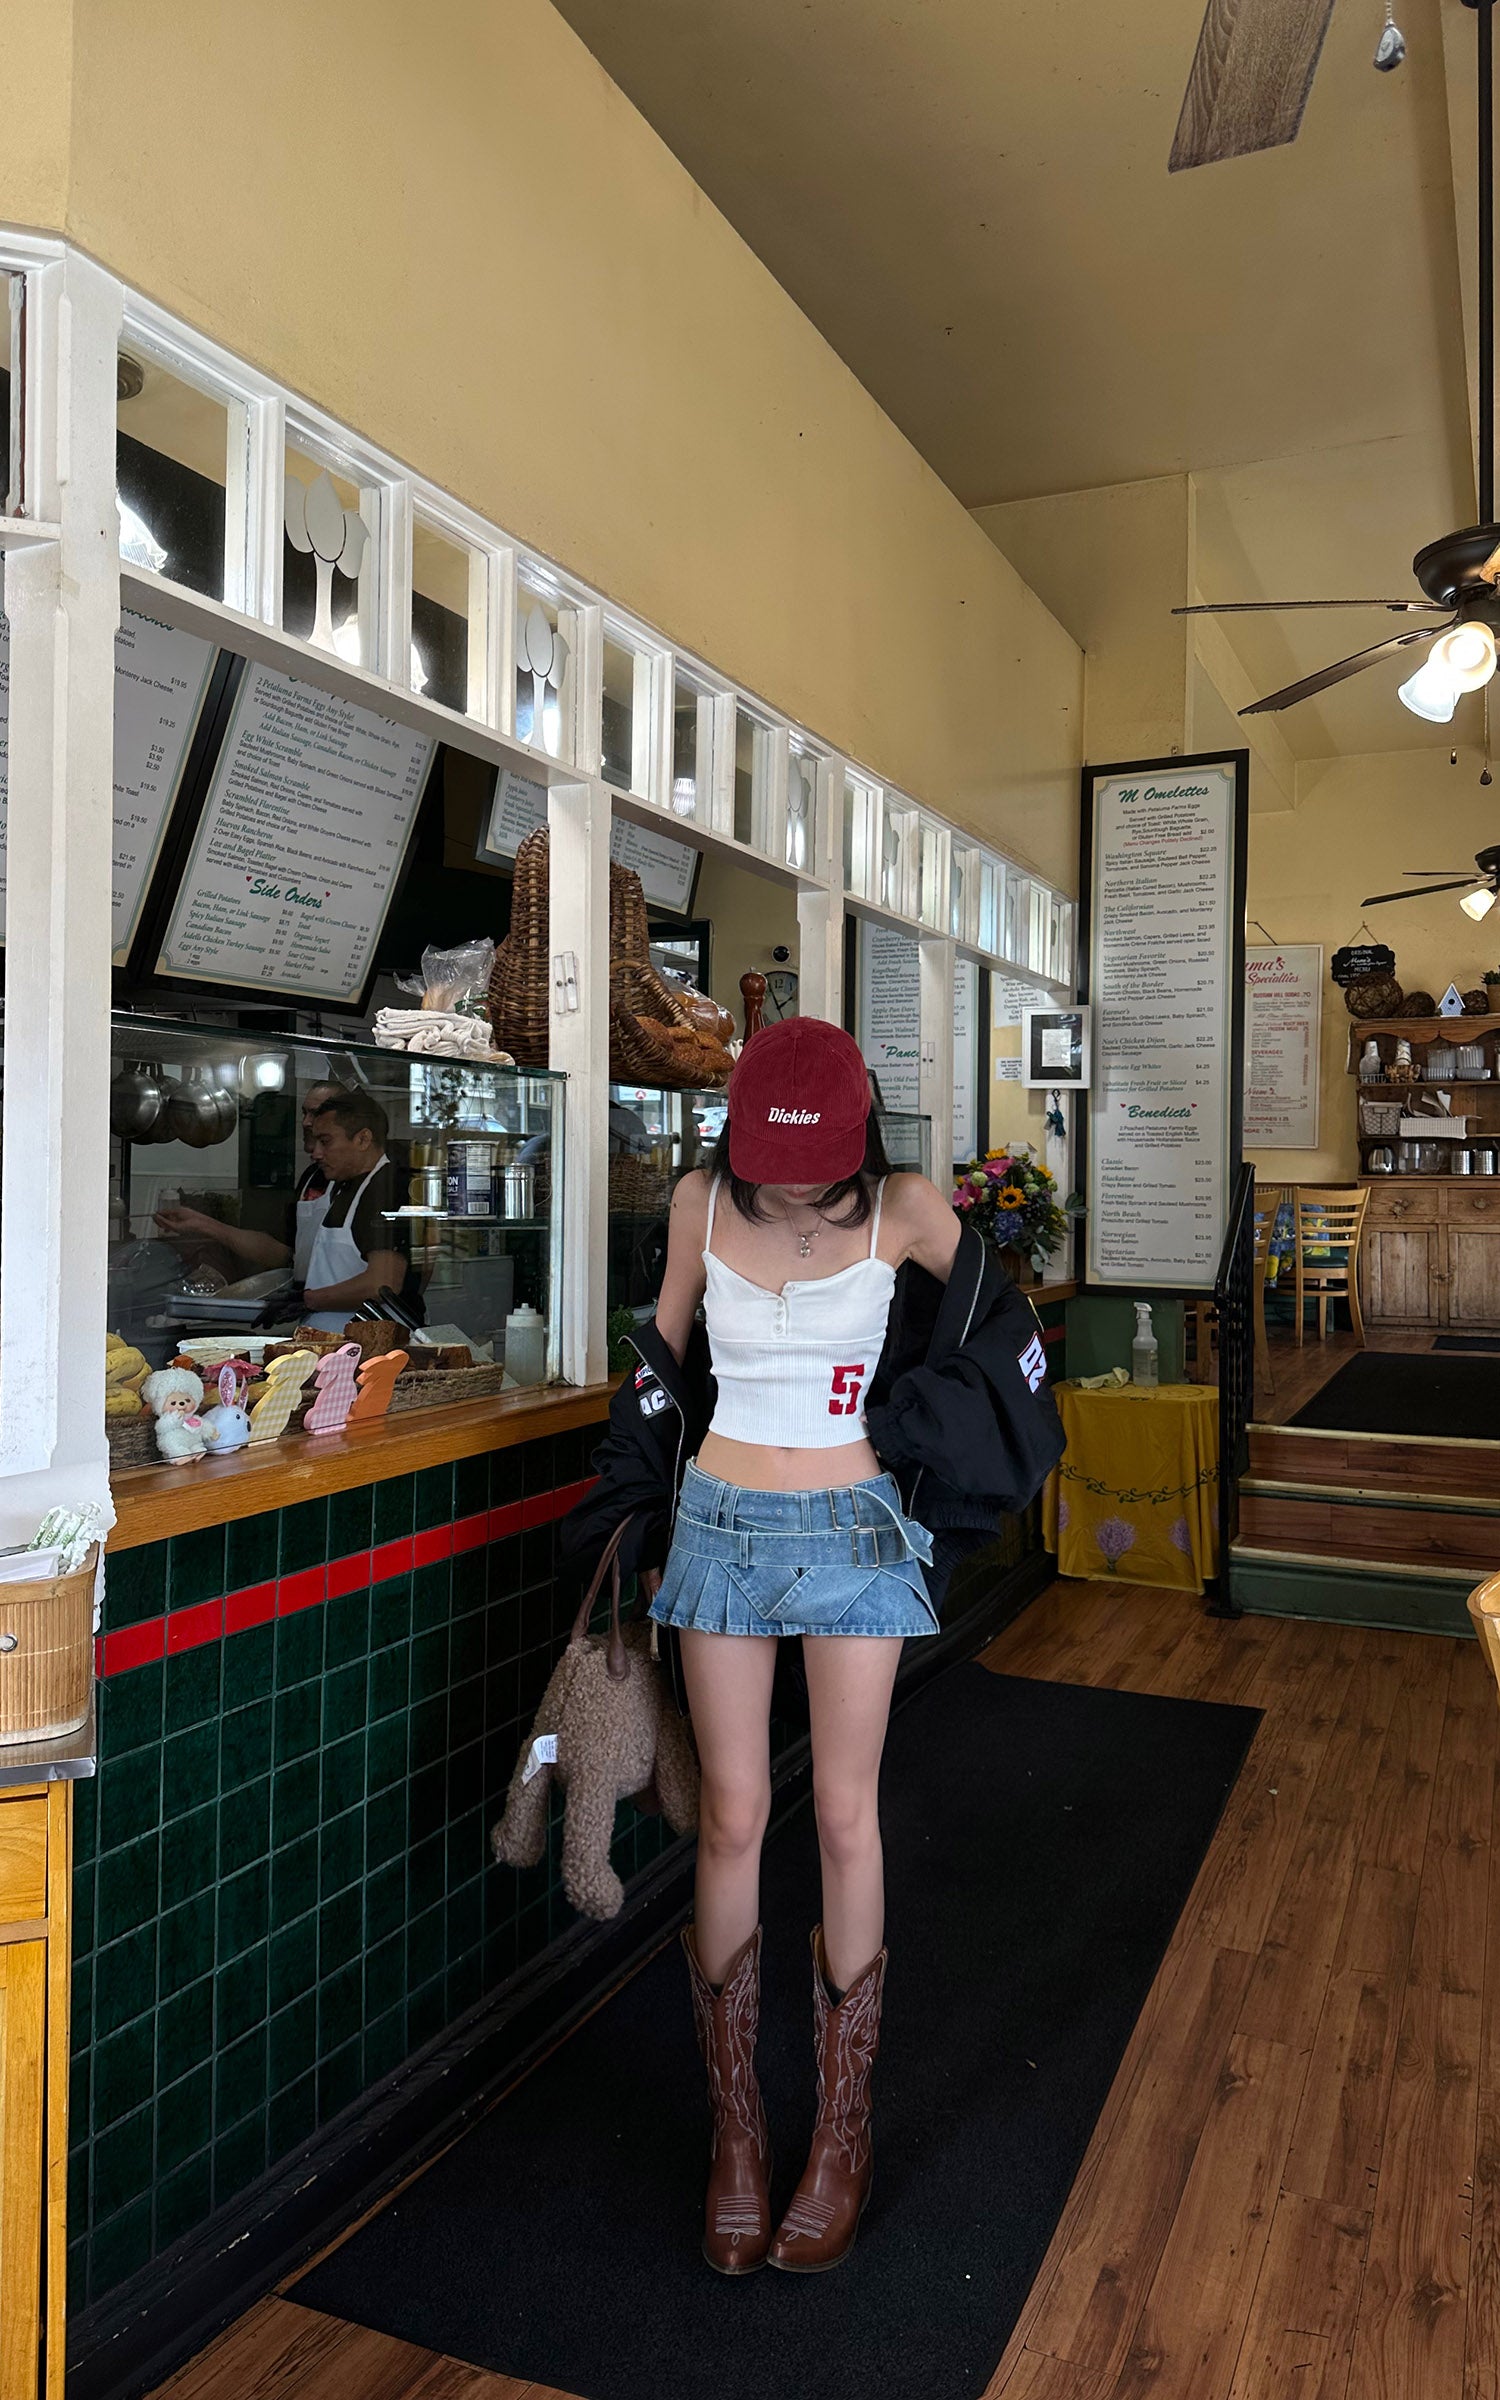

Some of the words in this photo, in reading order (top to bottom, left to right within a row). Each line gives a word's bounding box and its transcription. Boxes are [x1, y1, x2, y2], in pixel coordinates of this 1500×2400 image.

[114, 665, 140, 682] Monterey
[140, 675, 153, 686] Jack
[153, 680, 175, 695] Cheese,
[256, 677, 263, 685] 2
[262, 679, 292, 697] Petaluma
[292, 690, 312, 704] Farms
[311, 698, 326, 711] Eggs
[325, 705, 338, 717] Any
[241, 729, 255, 743] Egg
[255, 734, 274, 748] White
[274, 741, 302, 757] Scramble
[233, 759, 260, 774] Smoked
[258, 767, 282, 782] Salmon
[283, 775, 310, 791] Scramble
[125, 787, 140, 797] Toast
[1118, 788, 1139, 803] M
[1143, 785, 1210, 801] Omelettes
[224, 789, 259, 805] Scrambled
[258, 799, 290, 815] Florentine
[216, 817, 240, 831] Huevos
[240, 824, 273, 839] Rancheros
[208, 837, 223, 849] Lox
[222, 843, 237, 853] and
[236, 844, 255, 857] Bagel
[254, 849, 276, 861] Platter
[1143, 849, 1166, 858] Square
[1105, 879, 1134, 887] Northern
[1135, 877, 1157, 885] Italian
[196, 889, 218, 899] Grilled
[217, 893, 241, 905] Potatoes
[249, 878, 280, 898] Side
[284, 887, 322, 908] Orders
[235, 908, 249, 917] Link
[249, 911, 271, 923] Sausage
[1116, 904, 1154, 912] Californian
[185, 920, 213, 932] Canadian
[213, 926, 232, 935] Bacon
[188, 909, 204, 921] Spicy
[204, 913, 224, 923] Italian
[224, 917, 247, 929] Sausage
[177, 941, 192, 951] Eggs
[191, 944, 204, 954] Any
[204, 945, 219, 955] Style
[774, 978, 784, 989] 12
[767, 1106, 821, 1125] Dickies
[1128, 1105, 1191, 1118] Benedicts
[828, 1363, 865, 1416] 5
